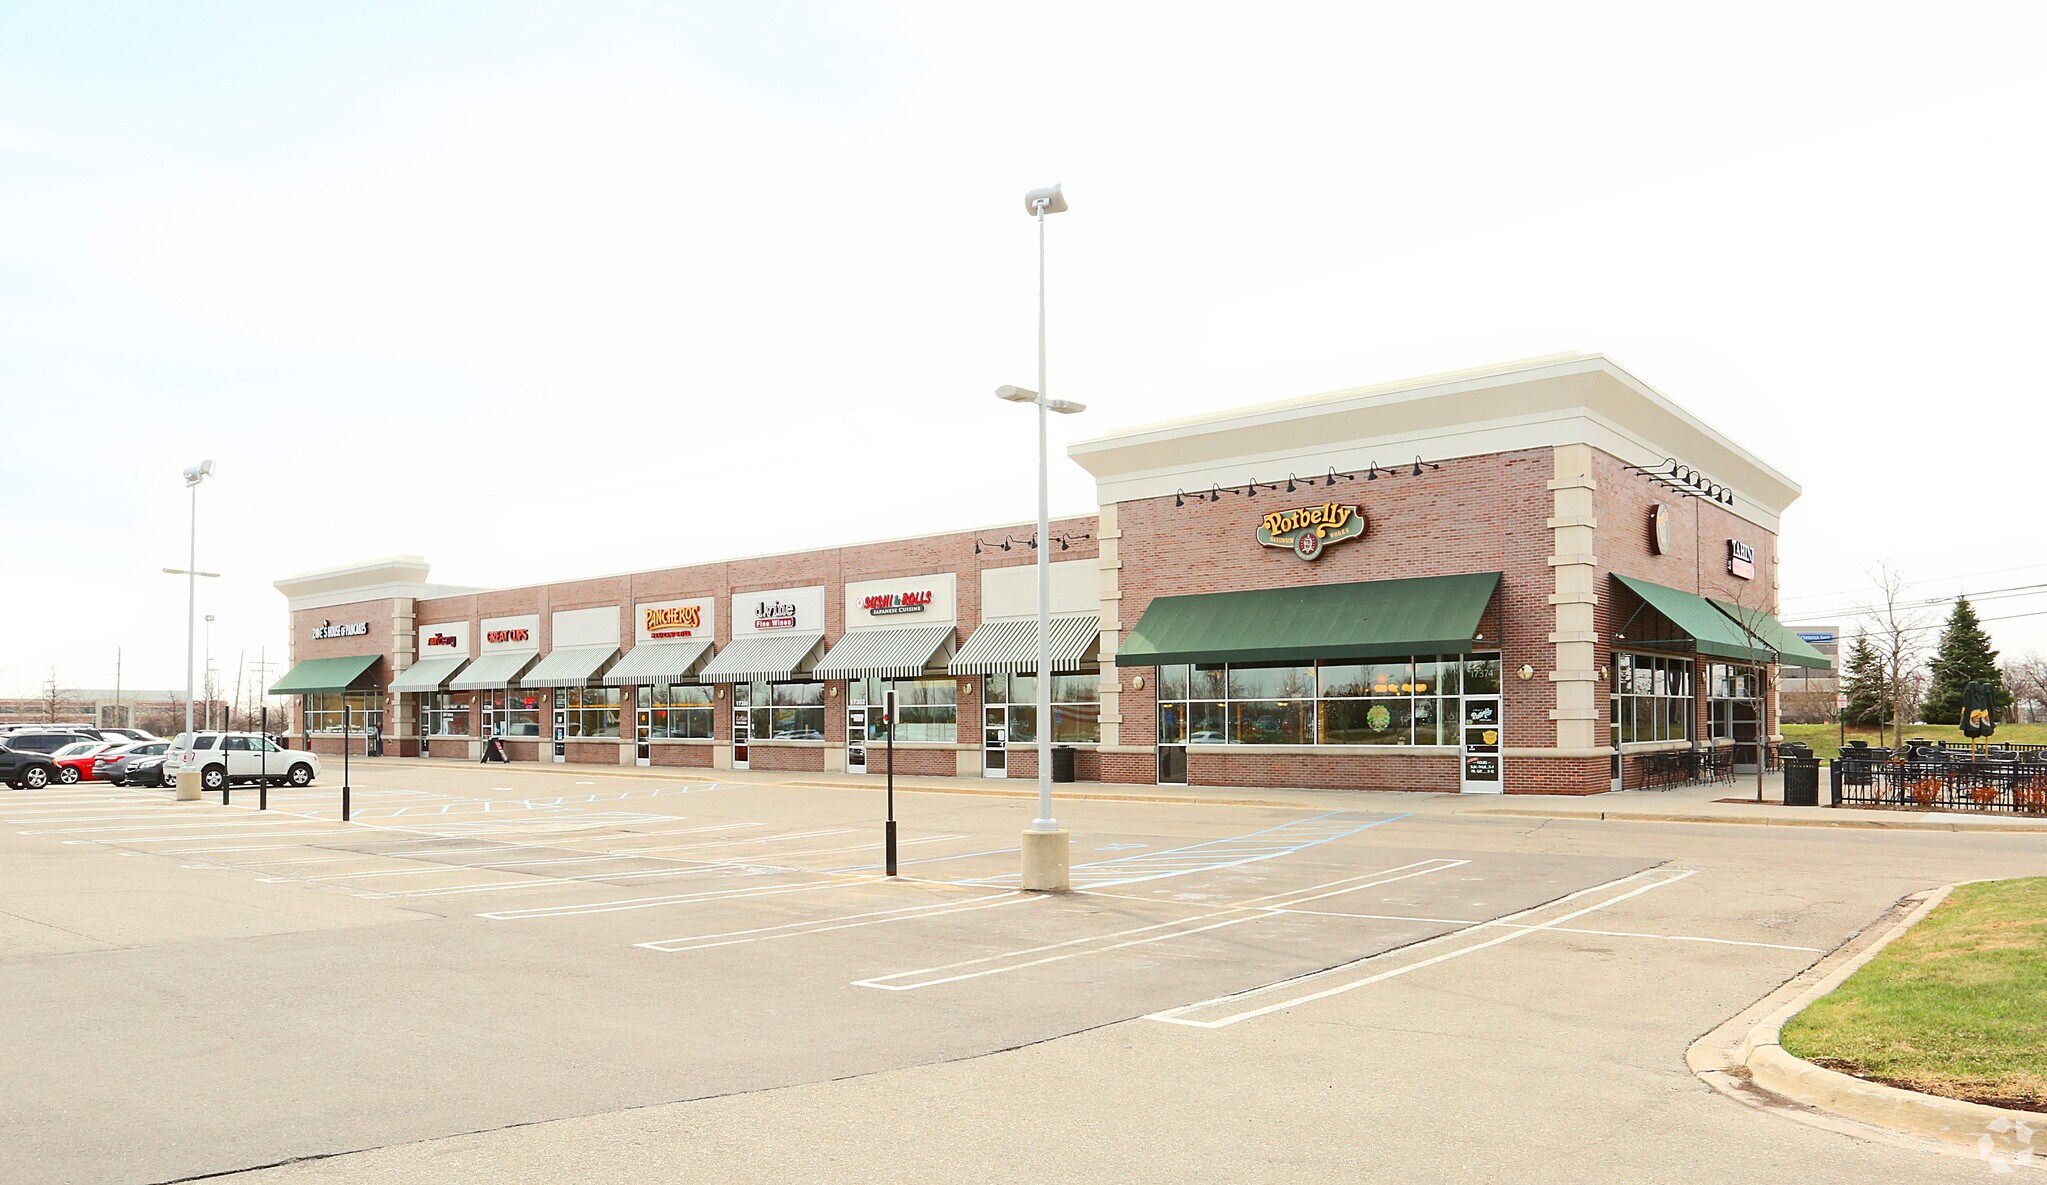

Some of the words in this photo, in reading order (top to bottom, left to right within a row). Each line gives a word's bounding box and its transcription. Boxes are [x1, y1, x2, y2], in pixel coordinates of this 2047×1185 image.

[1263, 503, 1351, 538] Potbelly
[864, 594, 893, 609] SUSHI
[894, 595, 901, 605] &
[901, 590, 932, 606] ROLLS
[873, 606, 897, 615] JAPANESE
[898, 604, 921, 613] CUISINE
[645, 606, 700, 629] PANCHEROS
[756, 620, 771, 628] Fine
[772, 619, 792, 627] Wines
[487, 631, 511, 643] GREAT
[511, 629, 529, 642] CLIPS
[1470, 669, 1494, 678] 17374
